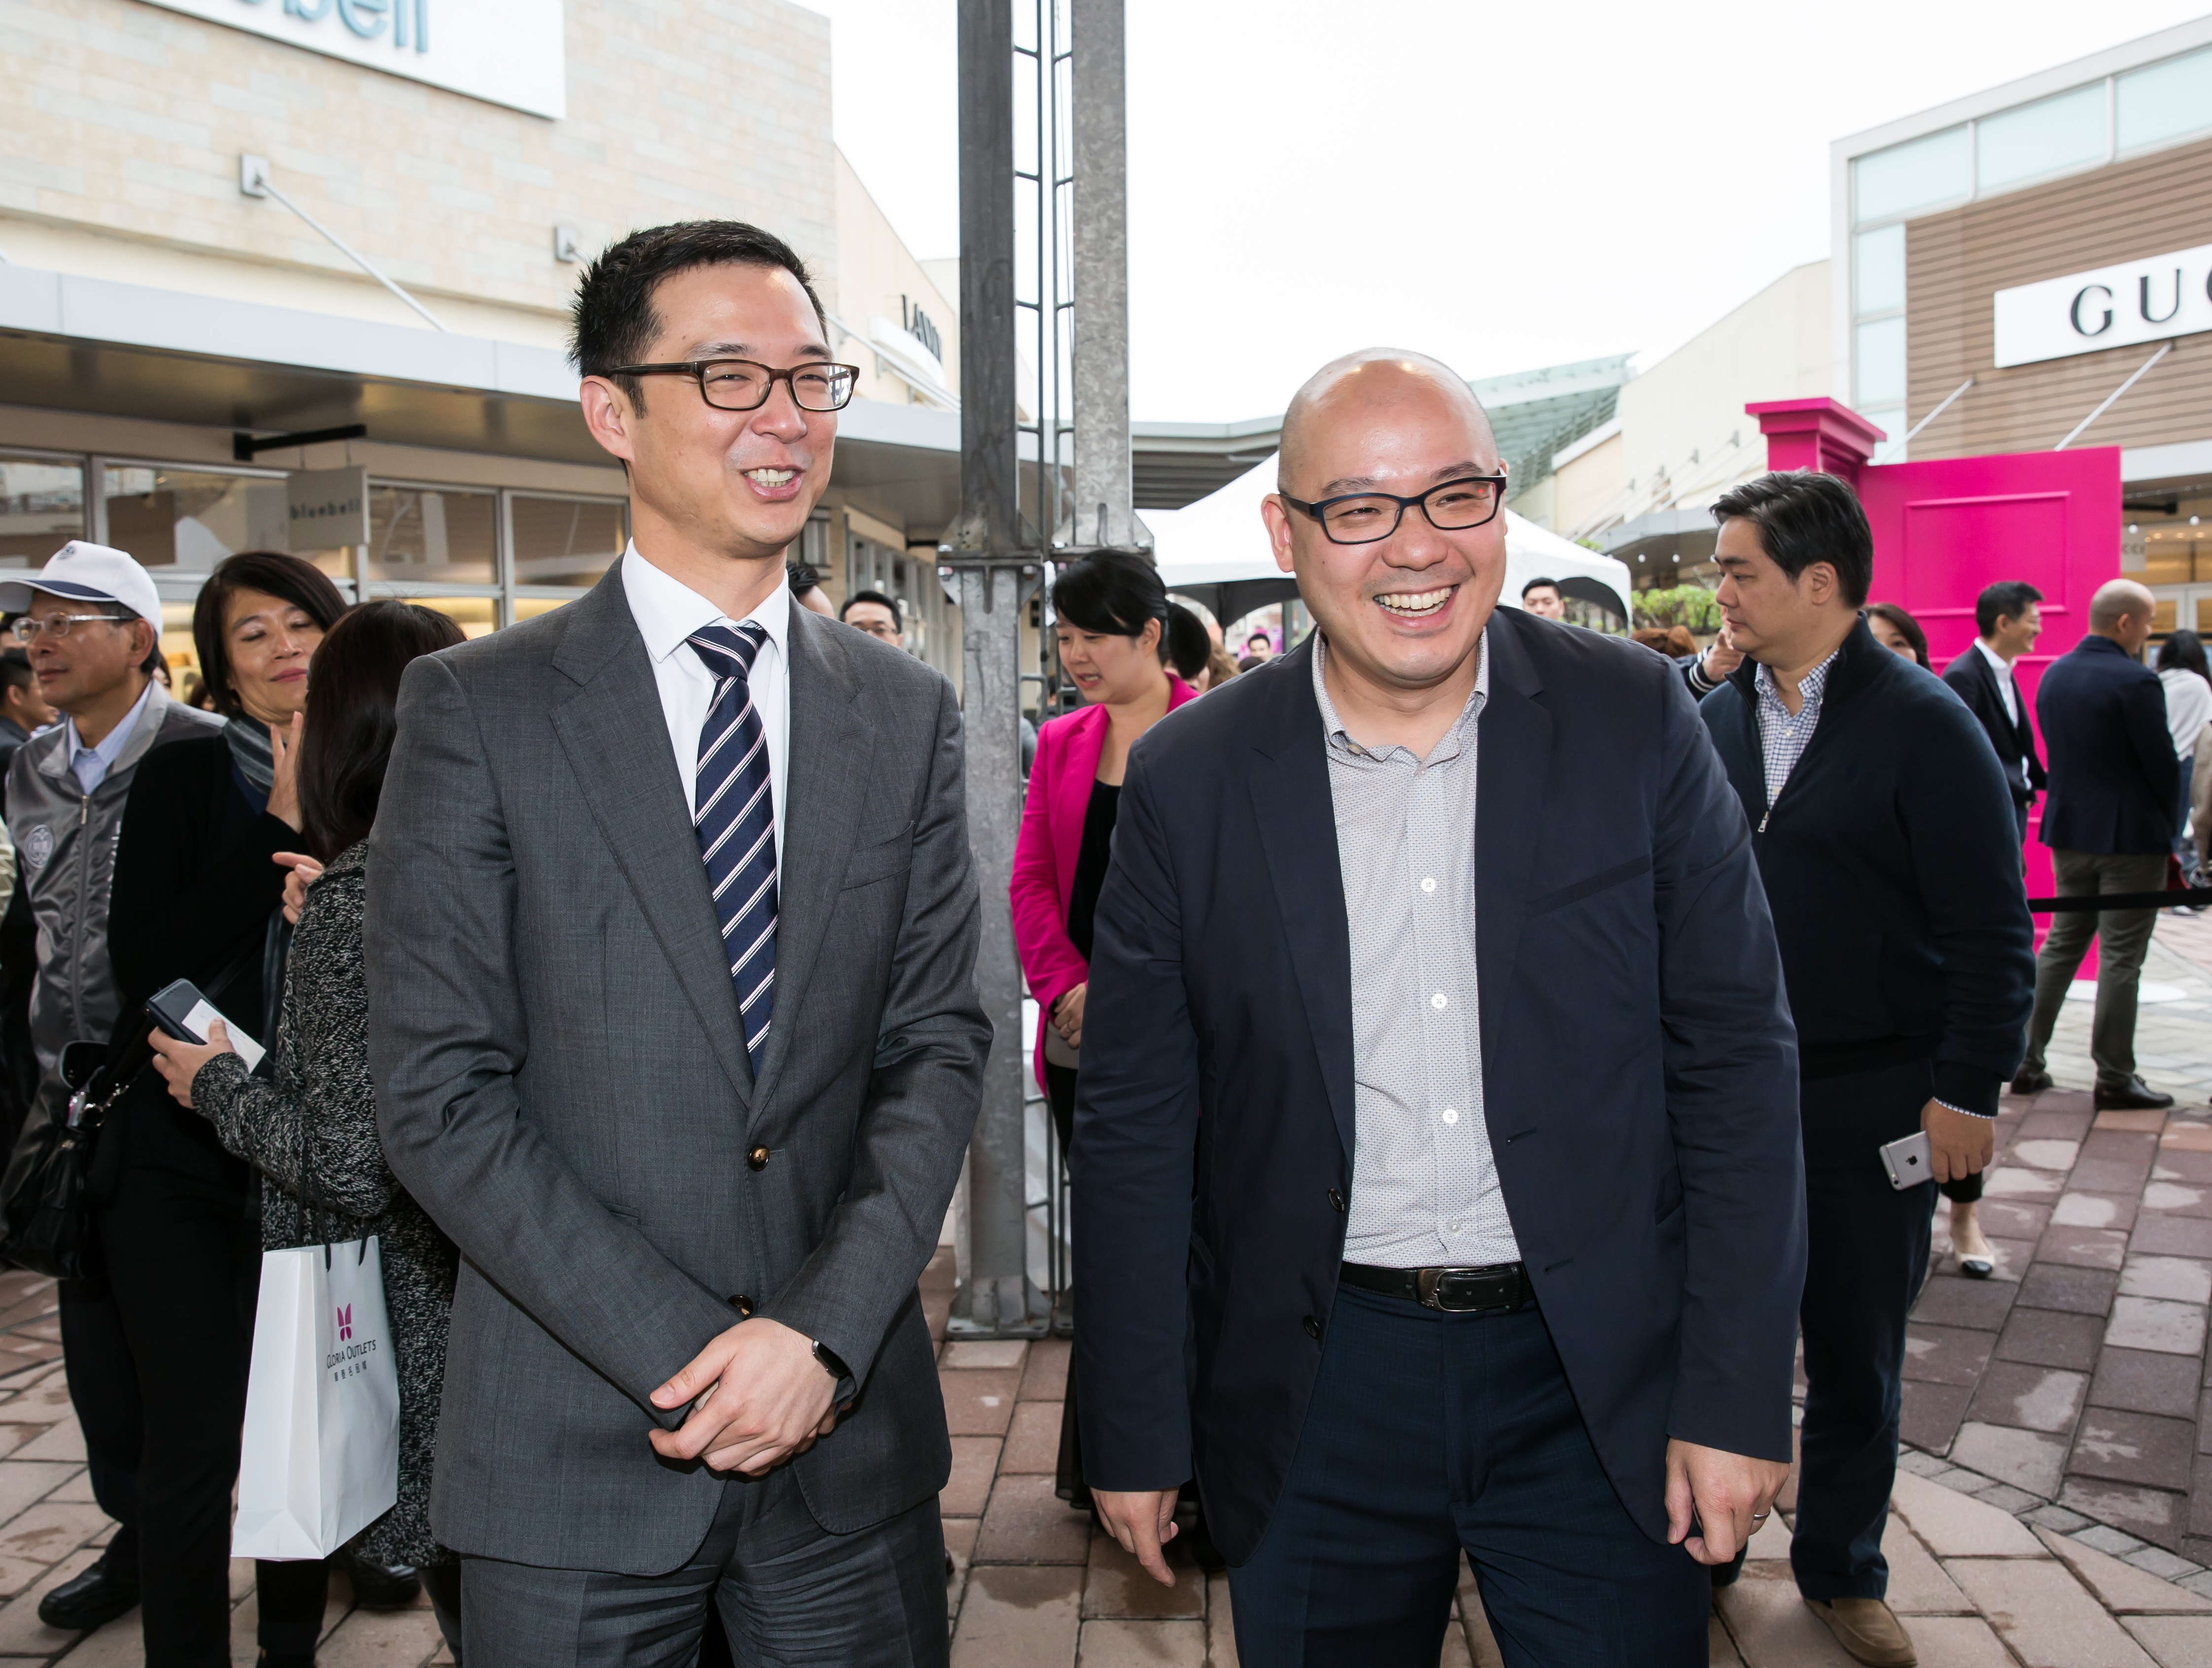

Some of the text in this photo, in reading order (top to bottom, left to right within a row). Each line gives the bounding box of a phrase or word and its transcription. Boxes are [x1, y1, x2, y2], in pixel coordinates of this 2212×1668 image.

[2071, 269, 2212, 336] GU
[290, 498, 361, 520] bluebell
[327, 1340, 376, 1369] GLORIA OUTLETS
